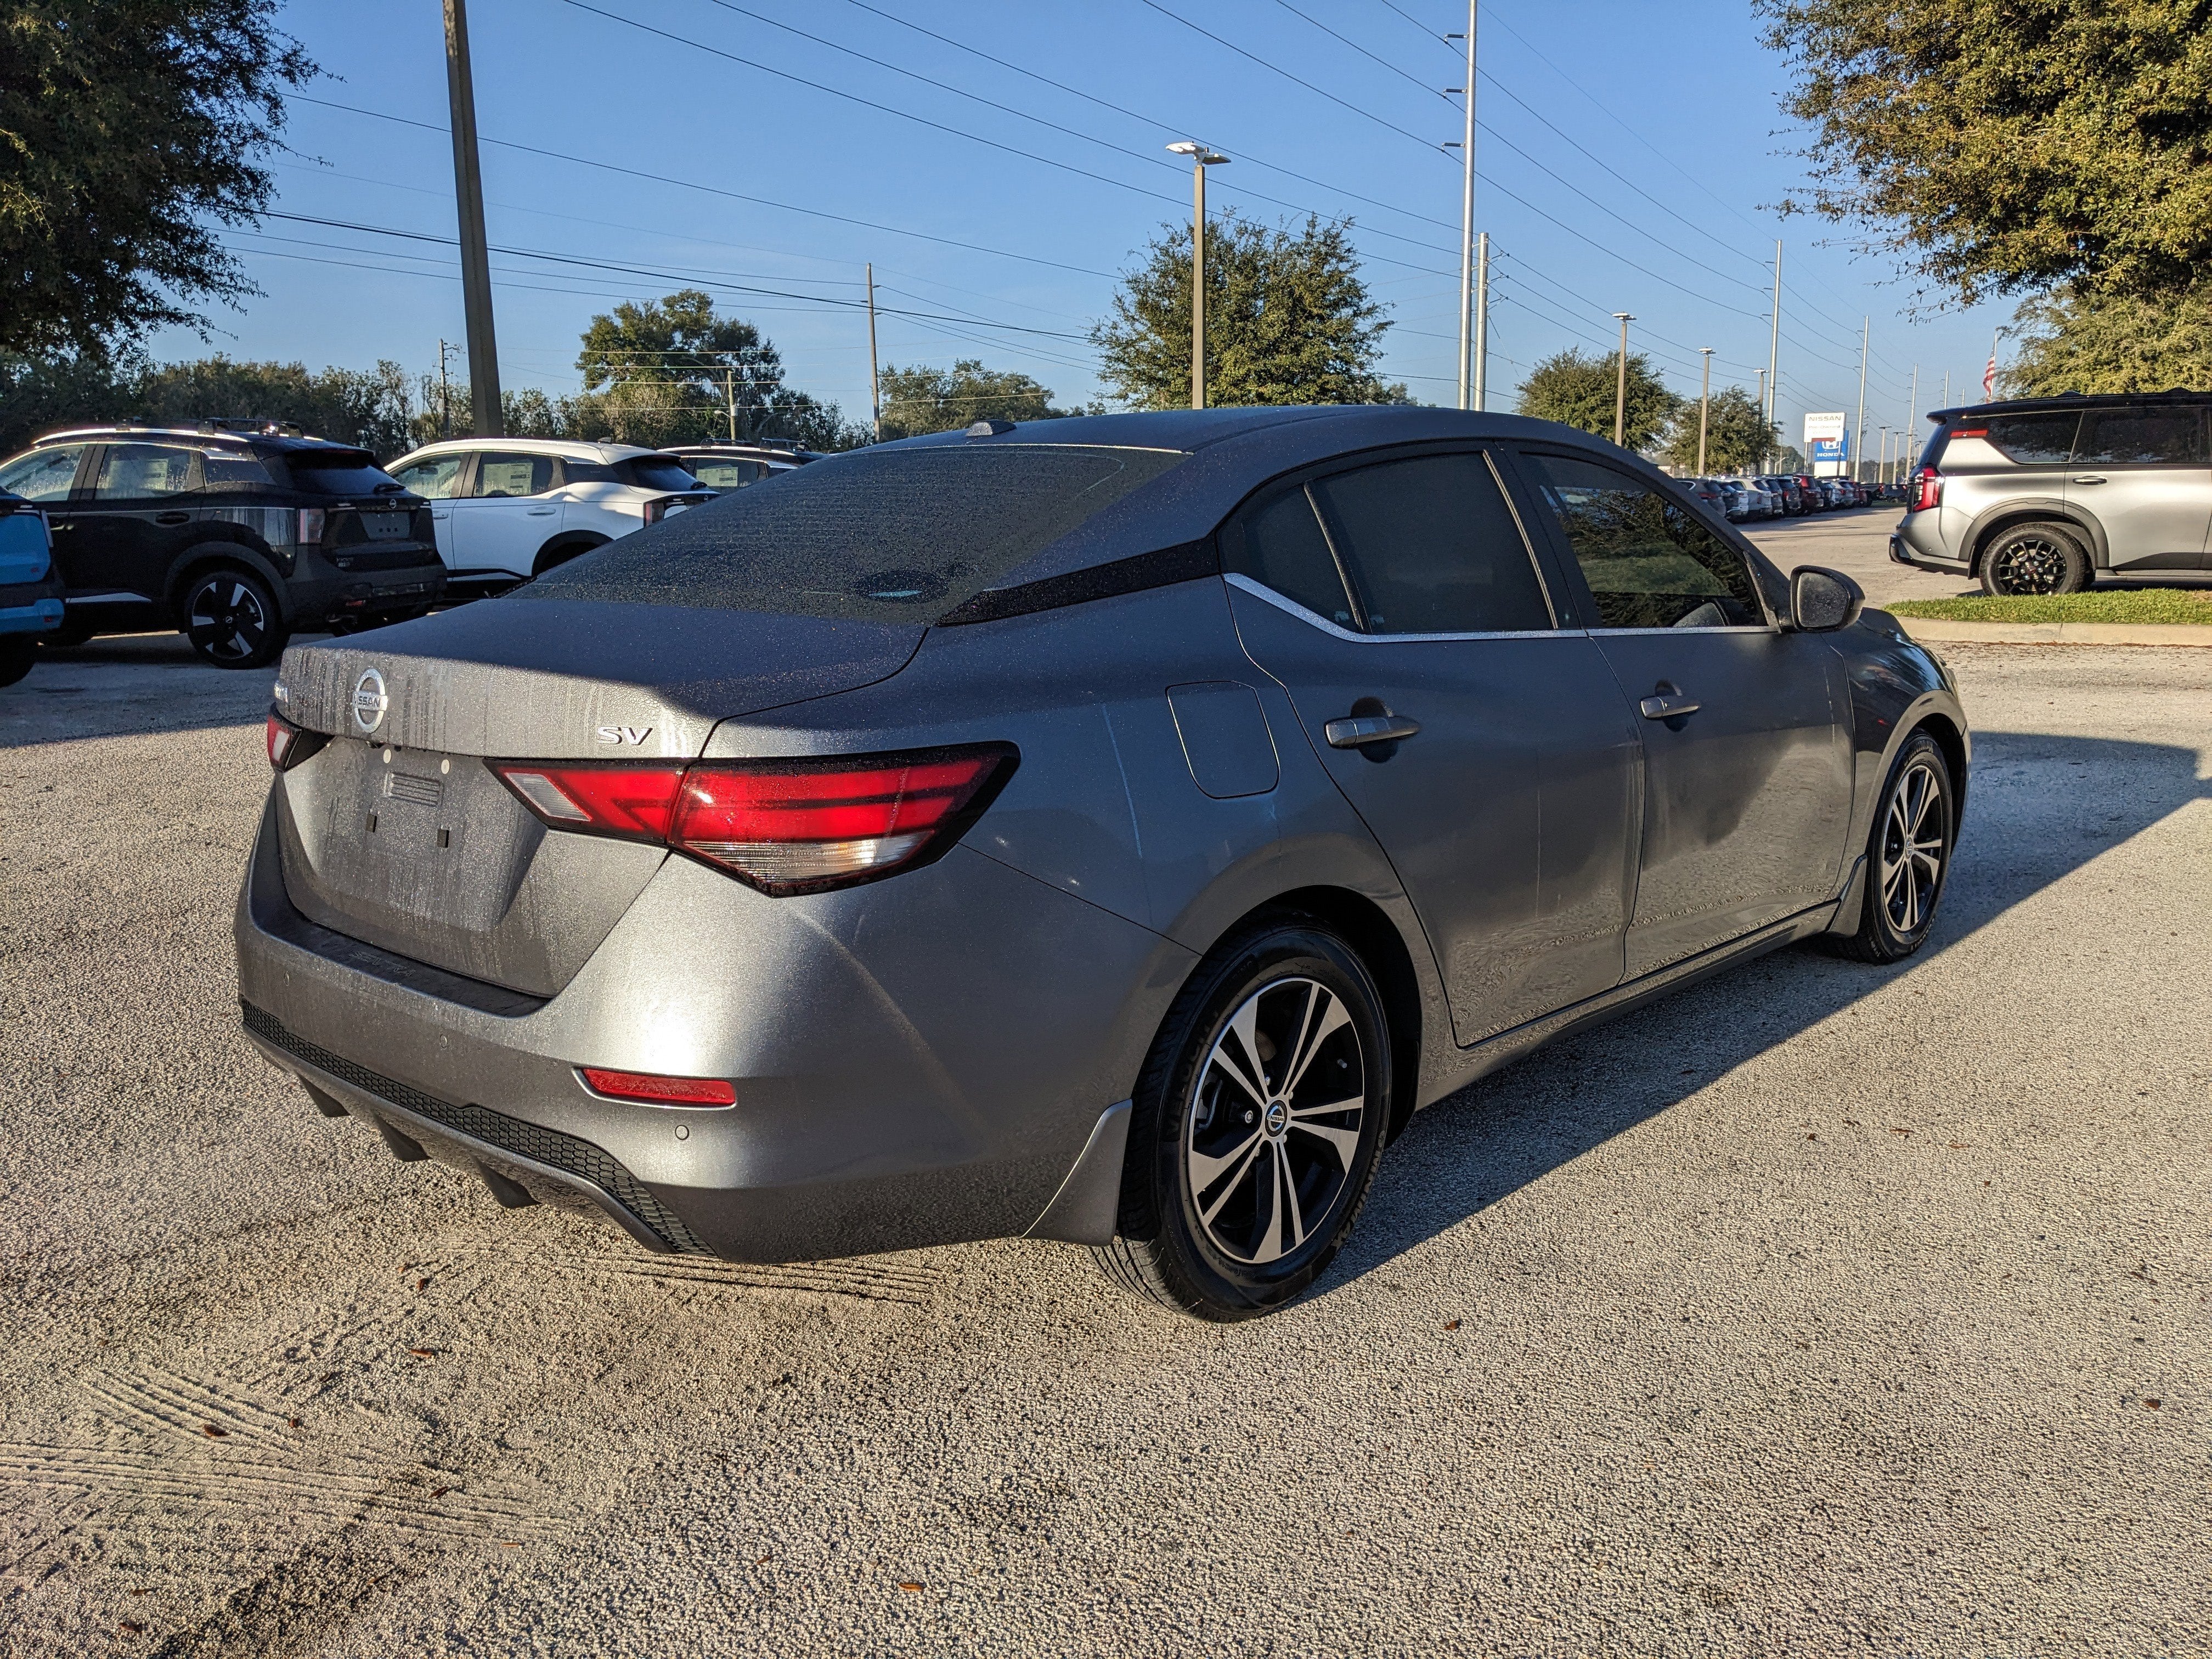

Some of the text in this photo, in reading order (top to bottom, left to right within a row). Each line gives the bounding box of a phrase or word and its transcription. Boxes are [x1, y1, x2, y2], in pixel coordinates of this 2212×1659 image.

[352, 693, 381, 708] SSAN
[597, 726, 653, 746] SV
[1332, 1130, 1385, 1250] OMNIMAX
